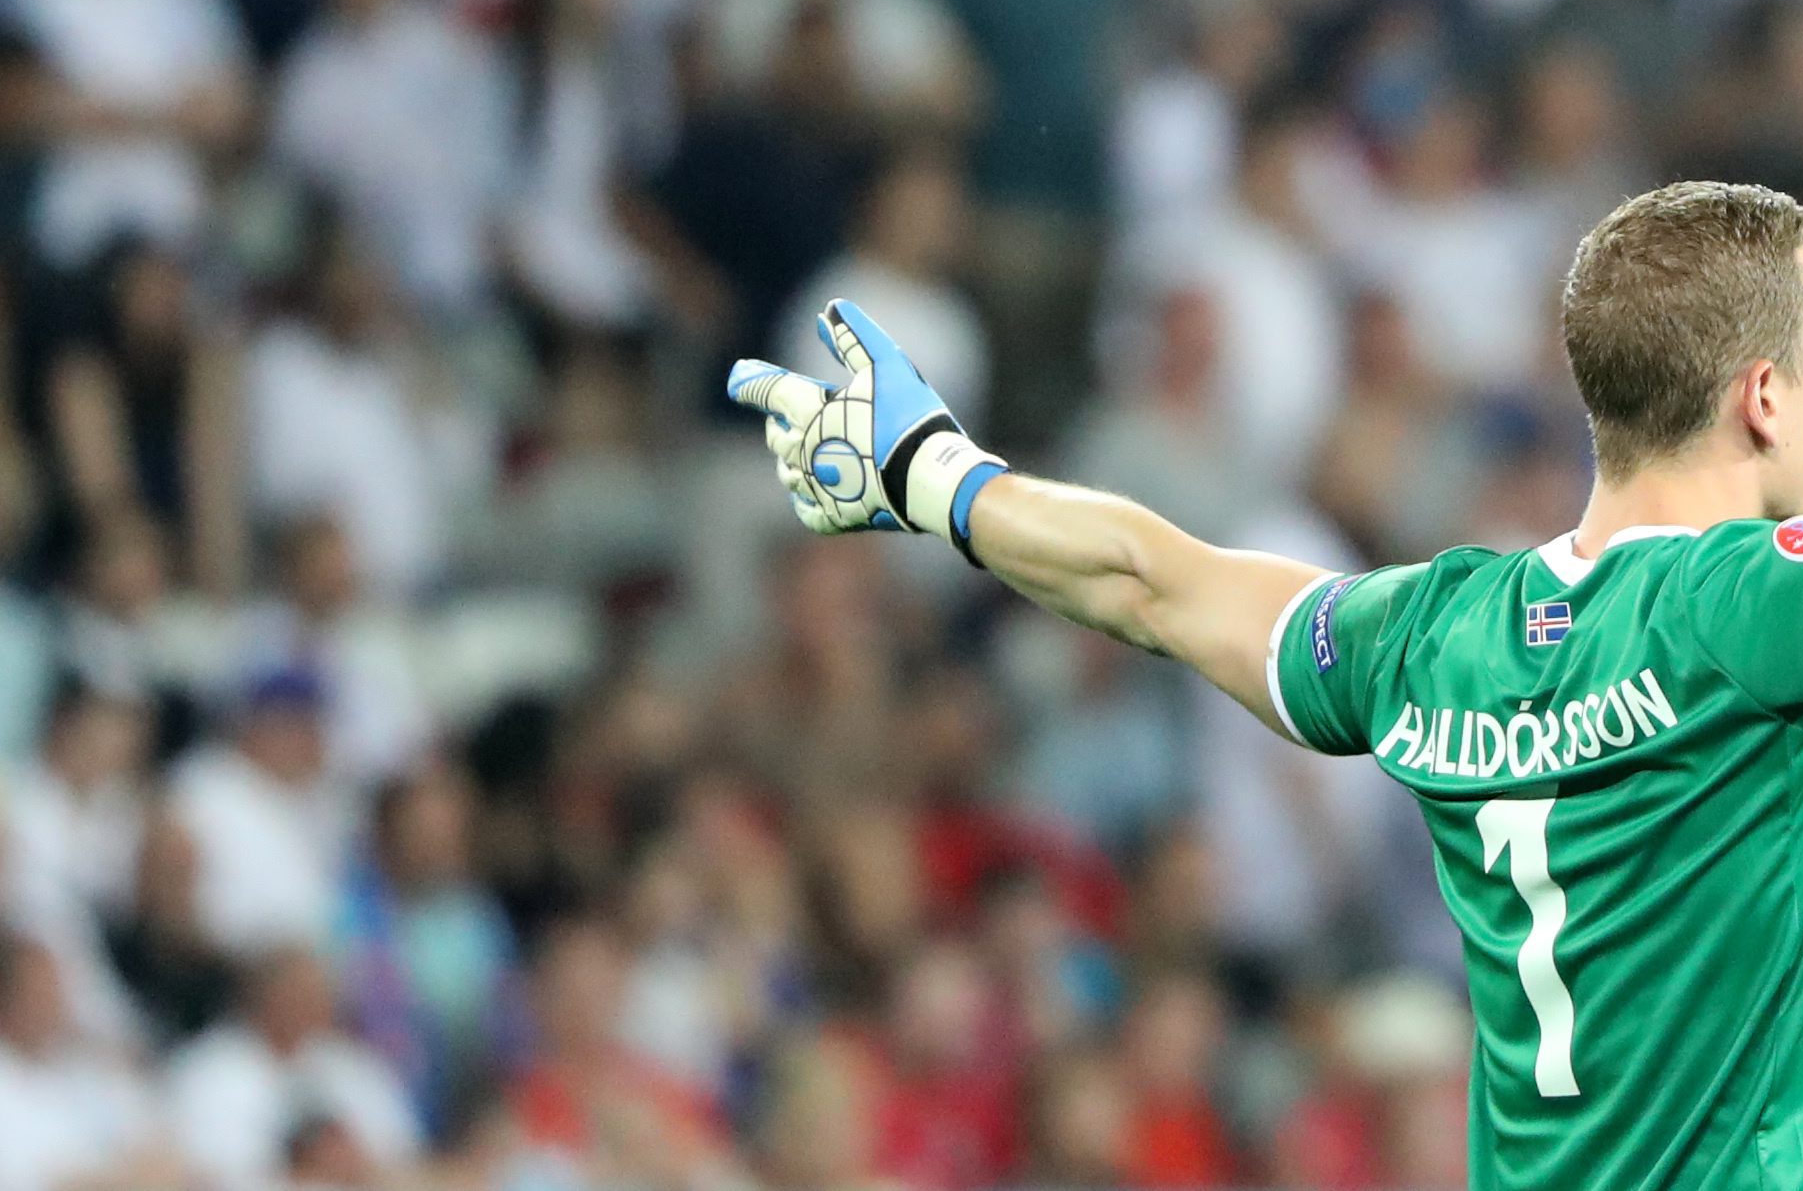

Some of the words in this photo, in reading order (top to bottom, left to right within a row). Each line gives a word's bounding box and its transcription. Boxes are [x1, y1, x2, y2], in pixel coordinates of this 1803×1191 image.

[1316, 584, 1342, 666] RESPECT
[1374, 668, 1678, 777] HALLDÓRSSON
[1475, 782, 1581, 1097] 1
